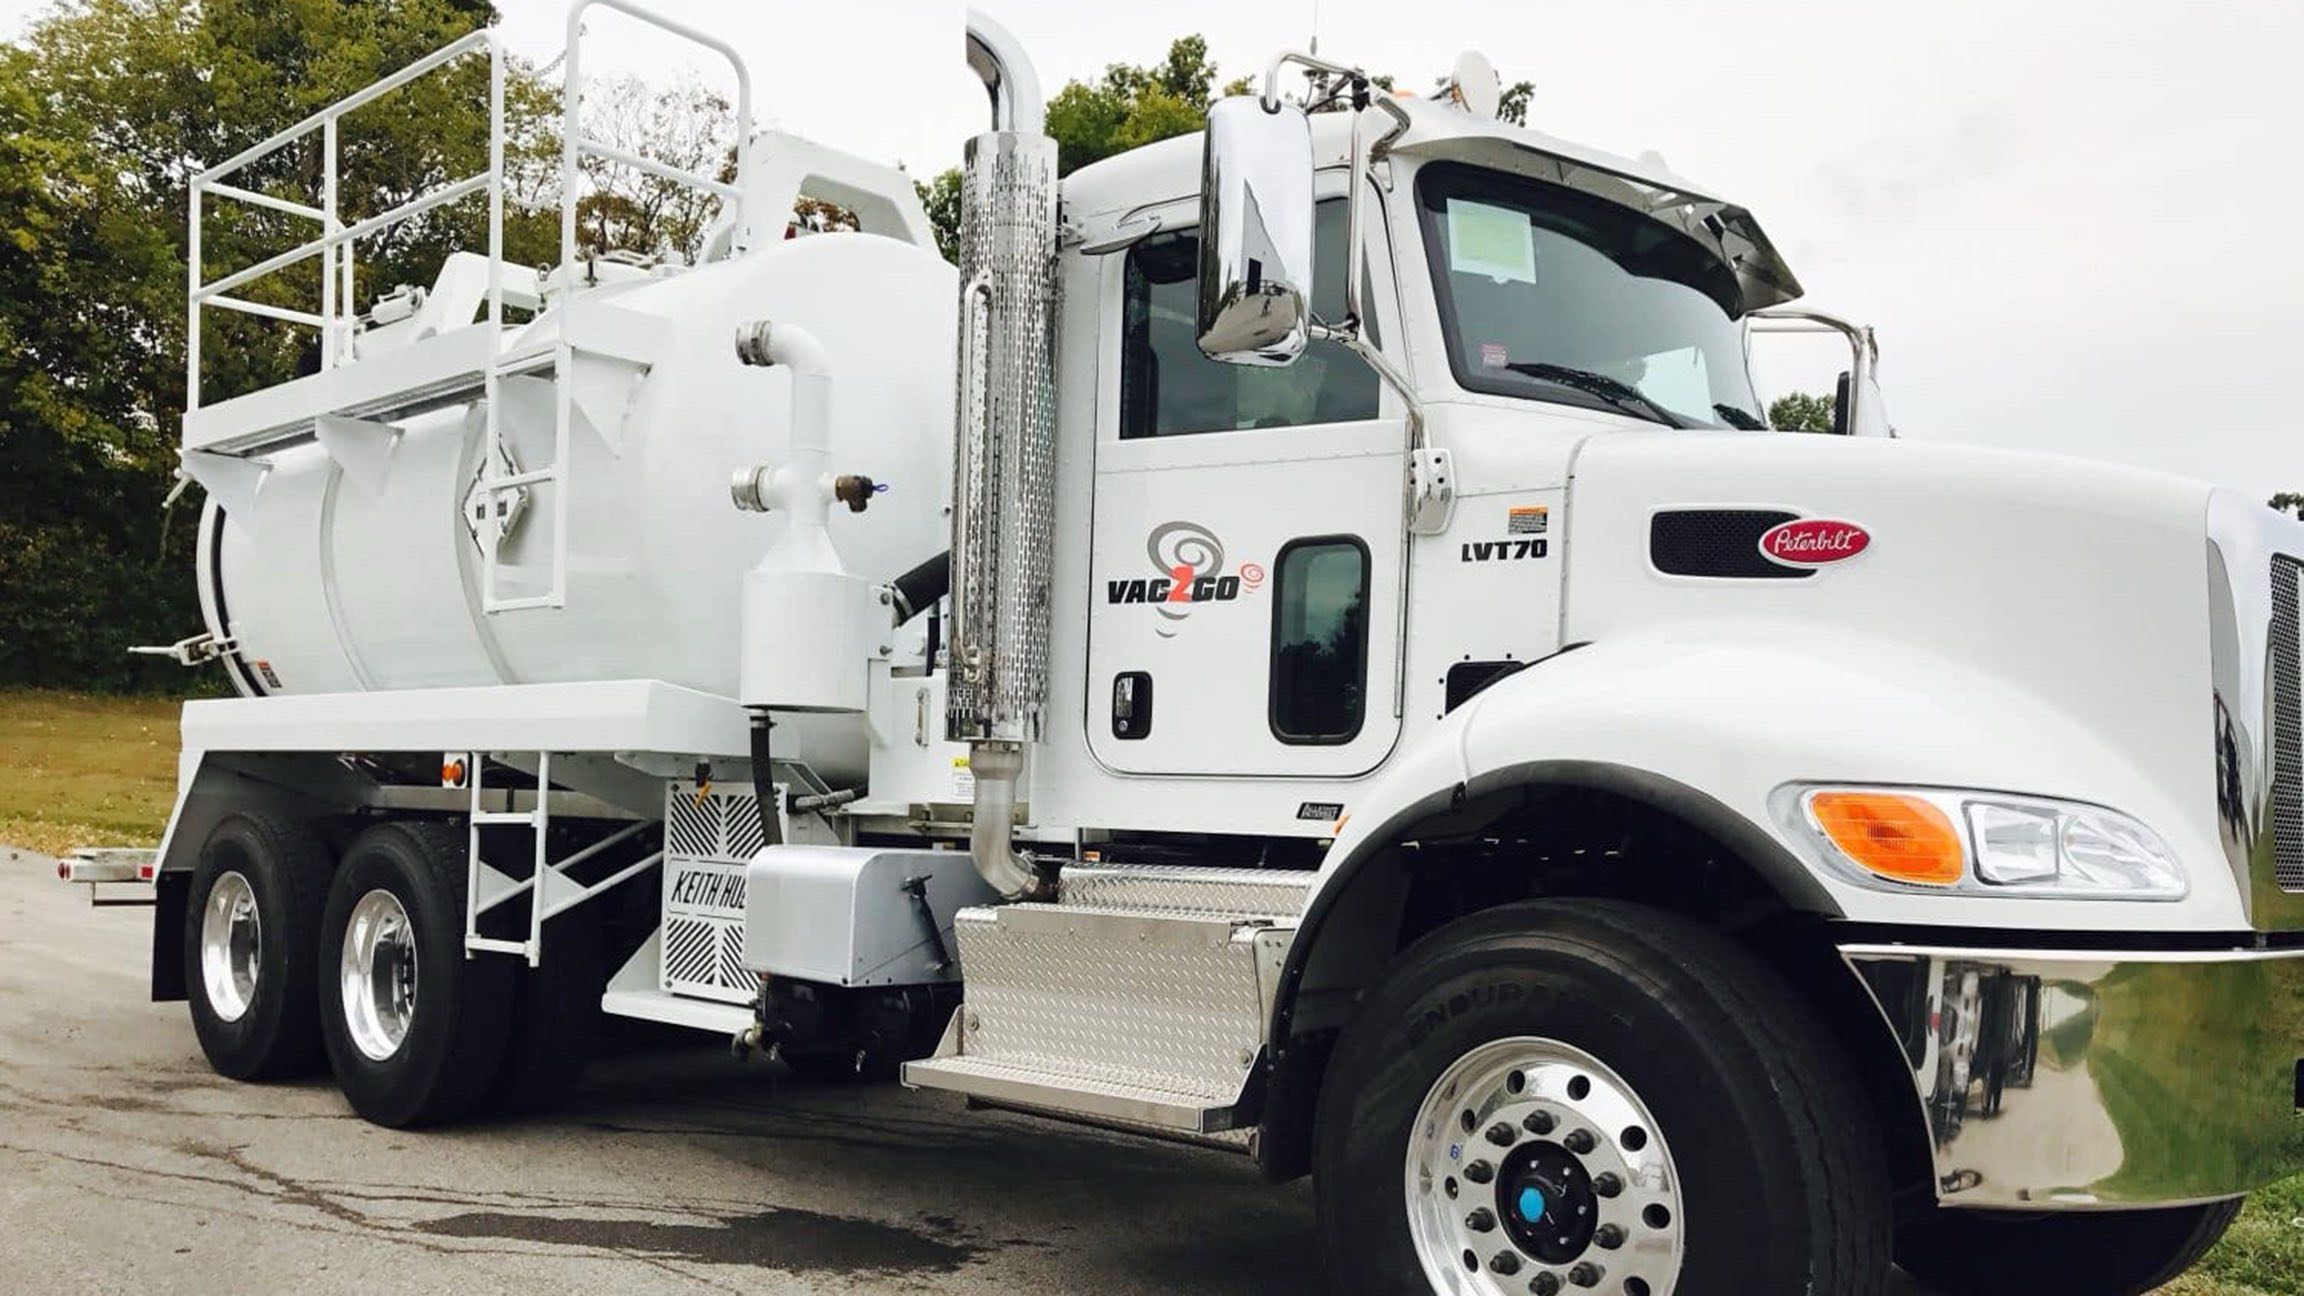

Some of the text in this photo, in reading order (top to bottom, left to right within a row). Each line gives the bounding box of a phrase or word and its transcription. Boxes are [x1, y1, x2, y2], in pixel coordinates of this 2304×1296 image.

[1462, 539, 1548, 562] LVT70
[1773, 529, 1861, 554] Peterbilt
[1108, 565, 1240, 604] VAC2GO
[671, 870, 724, 906] KEITH
